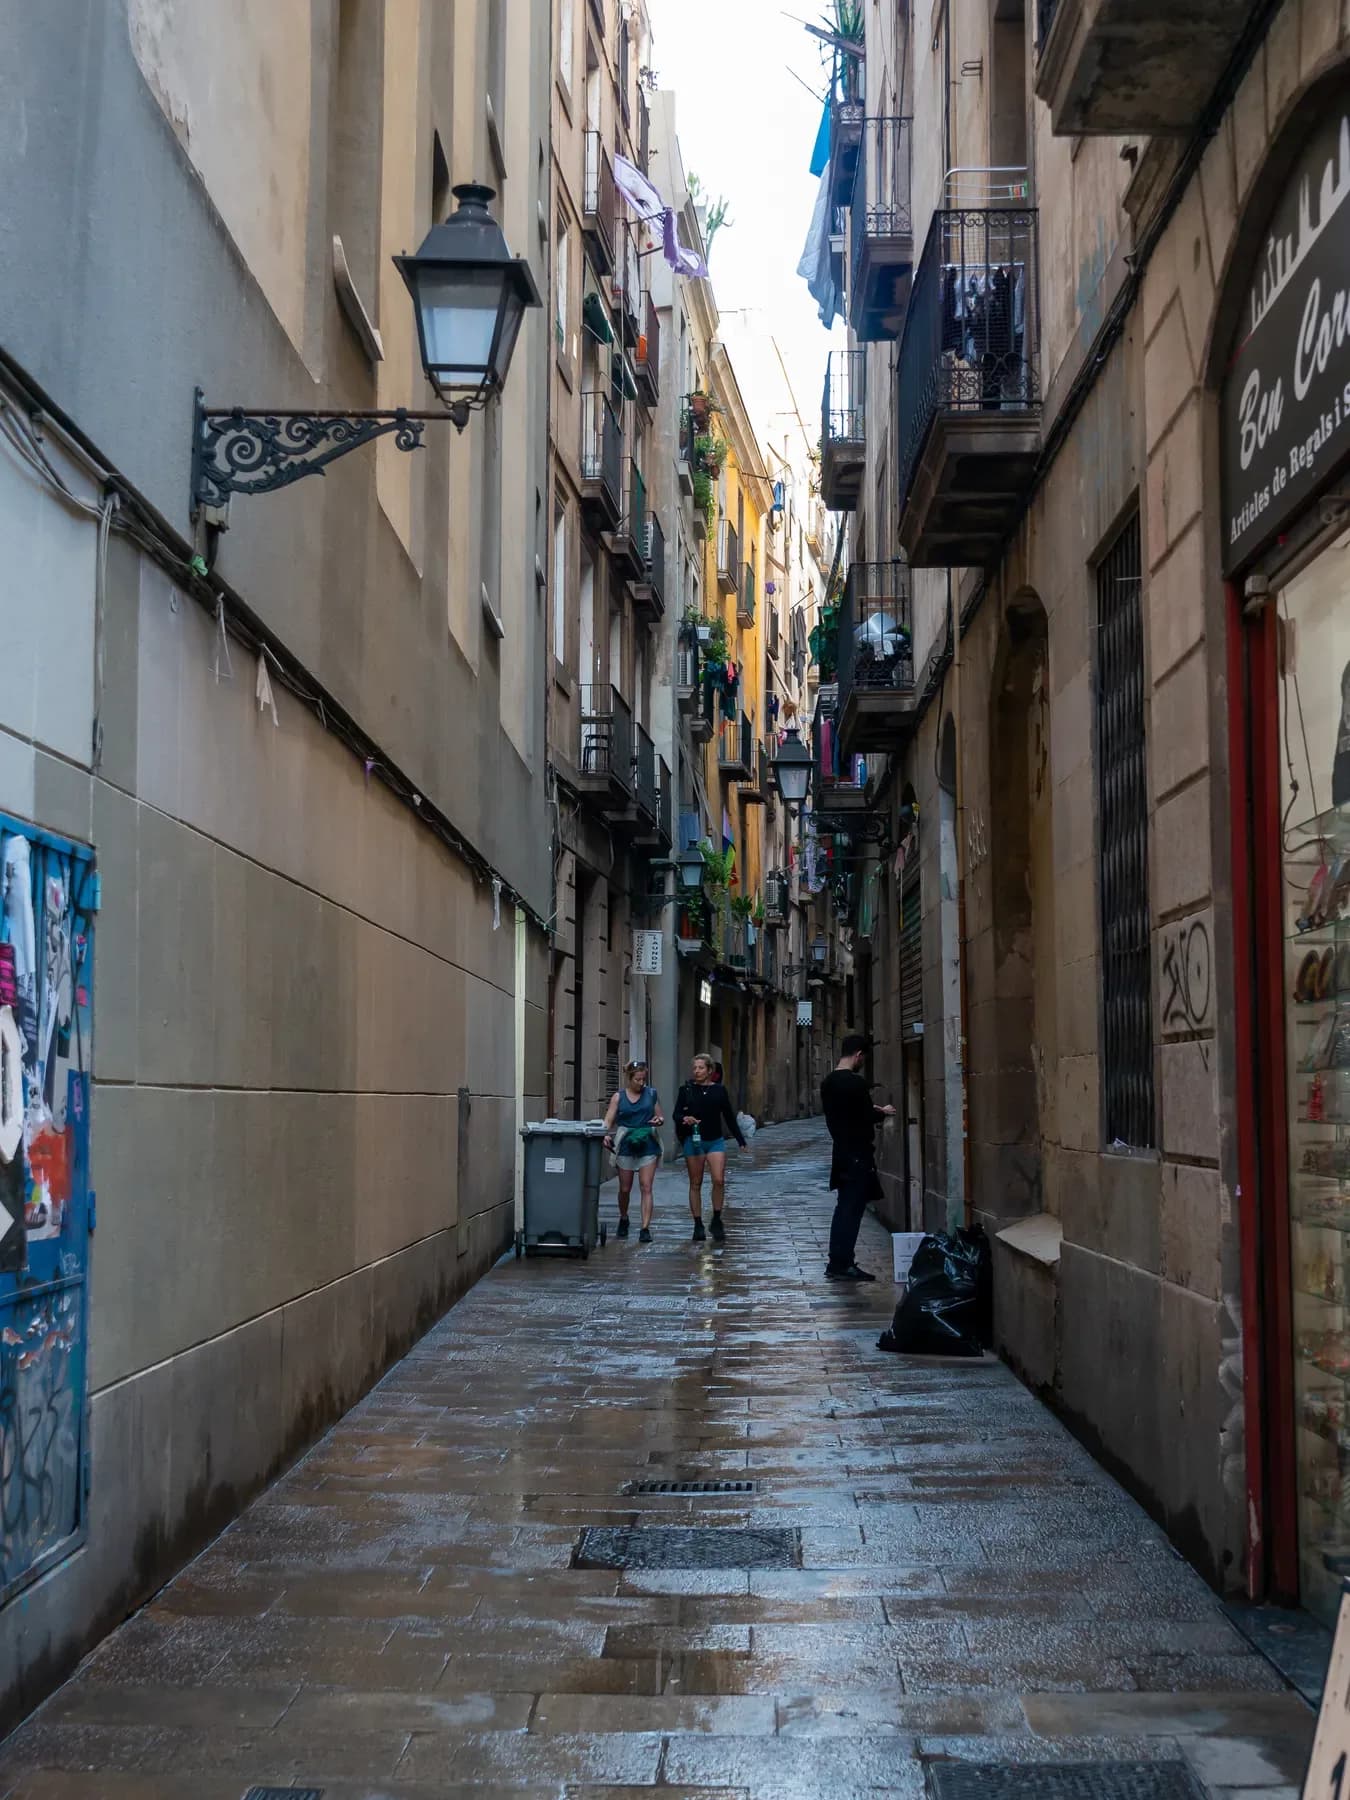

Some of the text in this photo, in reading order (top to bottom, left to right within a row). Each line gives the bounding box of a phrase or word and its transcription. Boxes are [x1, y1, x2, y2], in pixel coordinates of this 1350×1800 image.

[1231, 486, 1270, 544] Articles
[1273, 467, 1287, 496] de
[1290, 413, 1333, 478] Regals
[1335, 397, 1341, 427] i
[651, 935, 659, 970] LAUNDRY
